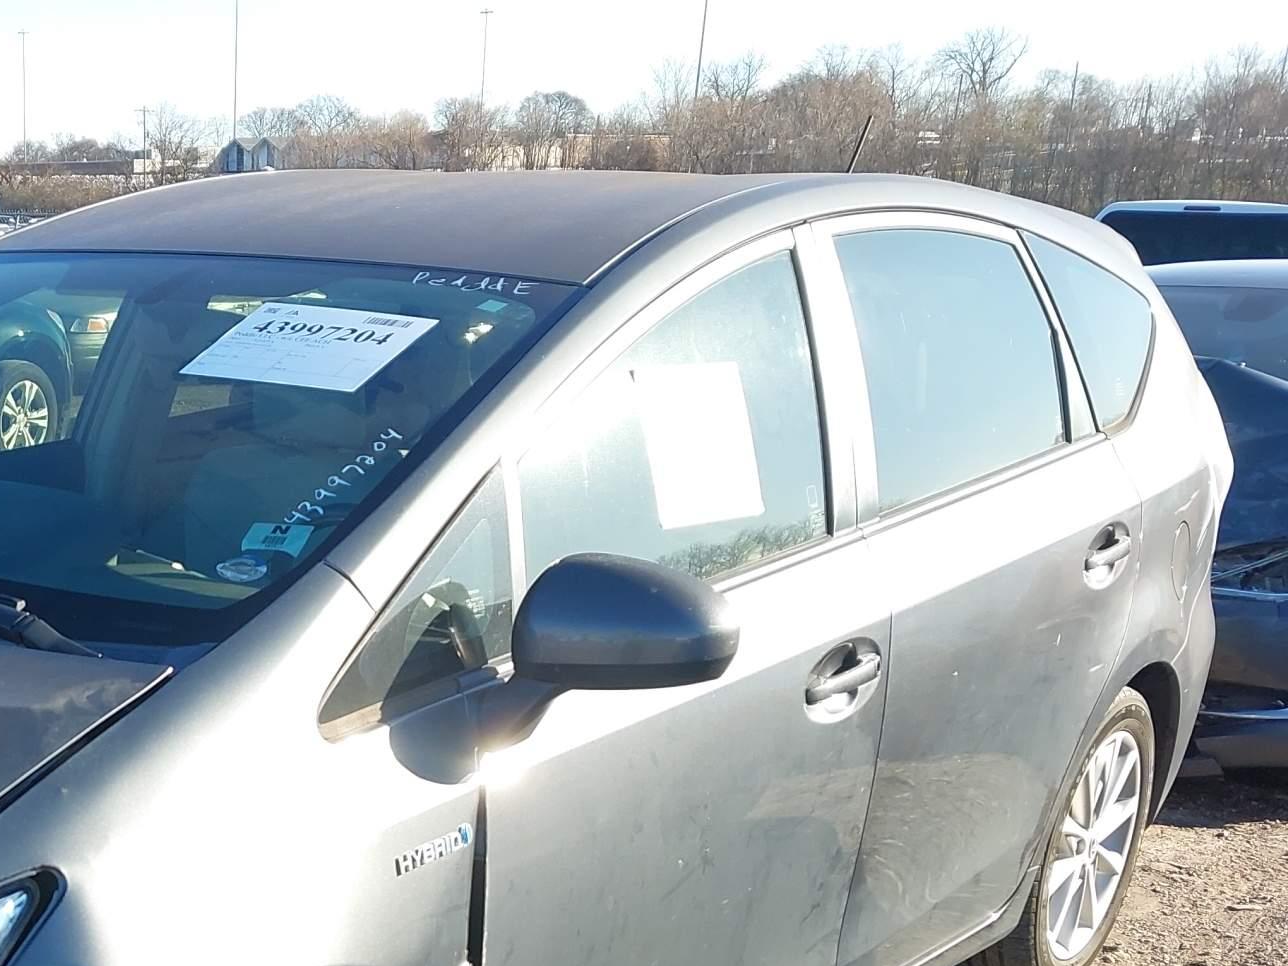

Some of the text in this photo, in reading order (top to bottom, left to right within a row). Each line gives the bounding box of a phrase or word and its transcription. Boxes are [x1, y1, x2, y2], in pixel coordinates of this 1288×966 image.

[253, 319, 396, 346] 43997204
[283, 427, 404, 525] 43997204
[270, 524, 292, 535] N
[394, 827, 467, 877] HYBRID
